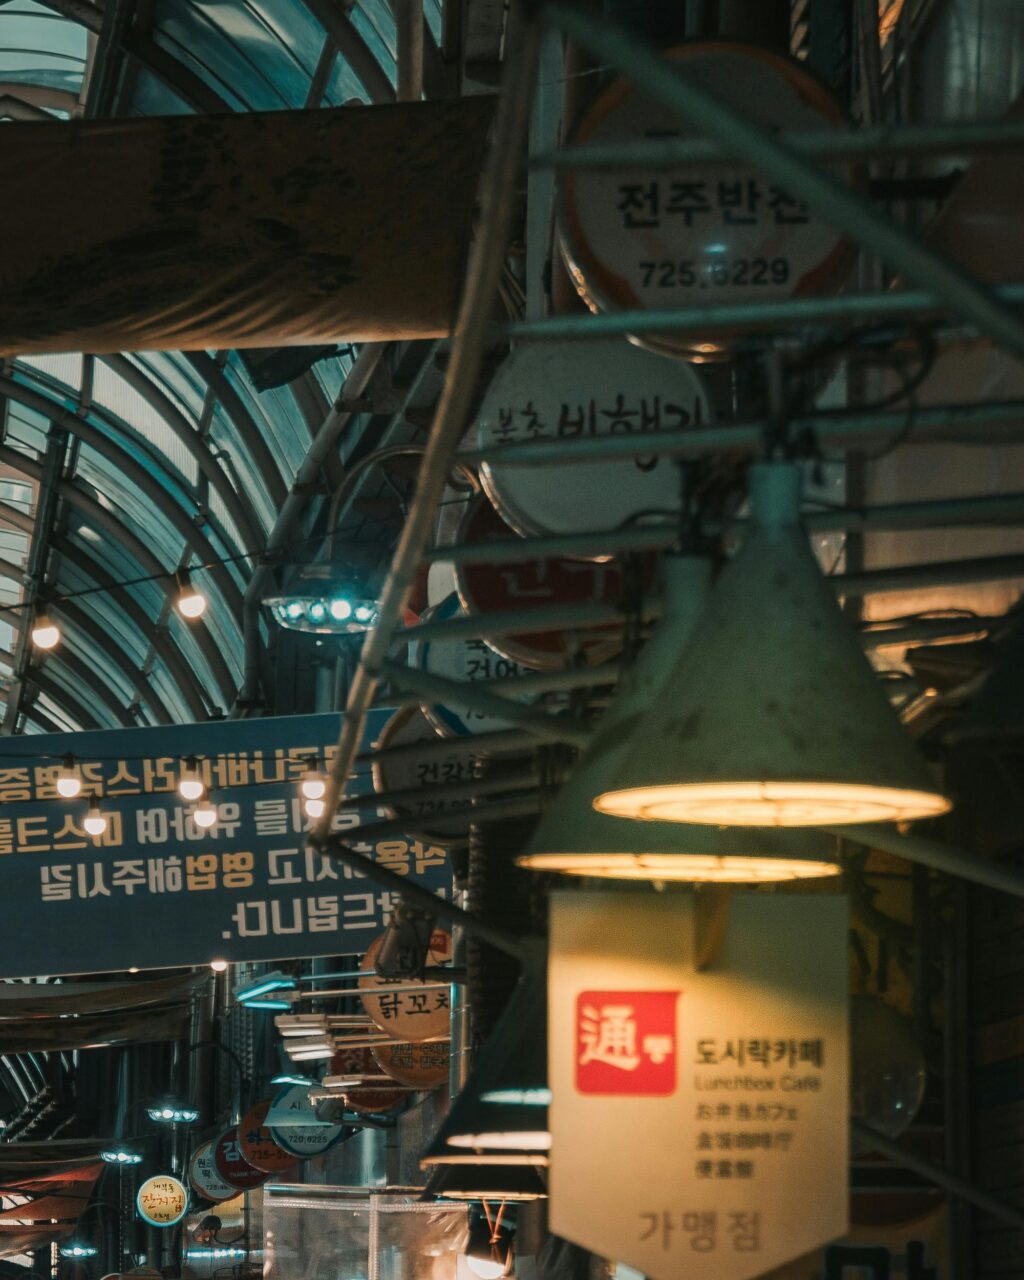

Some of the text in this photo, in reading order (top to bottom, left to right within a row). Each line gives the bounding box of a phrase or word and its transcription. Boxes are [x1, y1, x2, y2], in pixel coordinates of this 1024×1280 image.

[464, 658, 539, 681] 건어
[695, 1037, 824, 1067] 도시락카페
[638, 1211, 761, 1252] 가맹점
